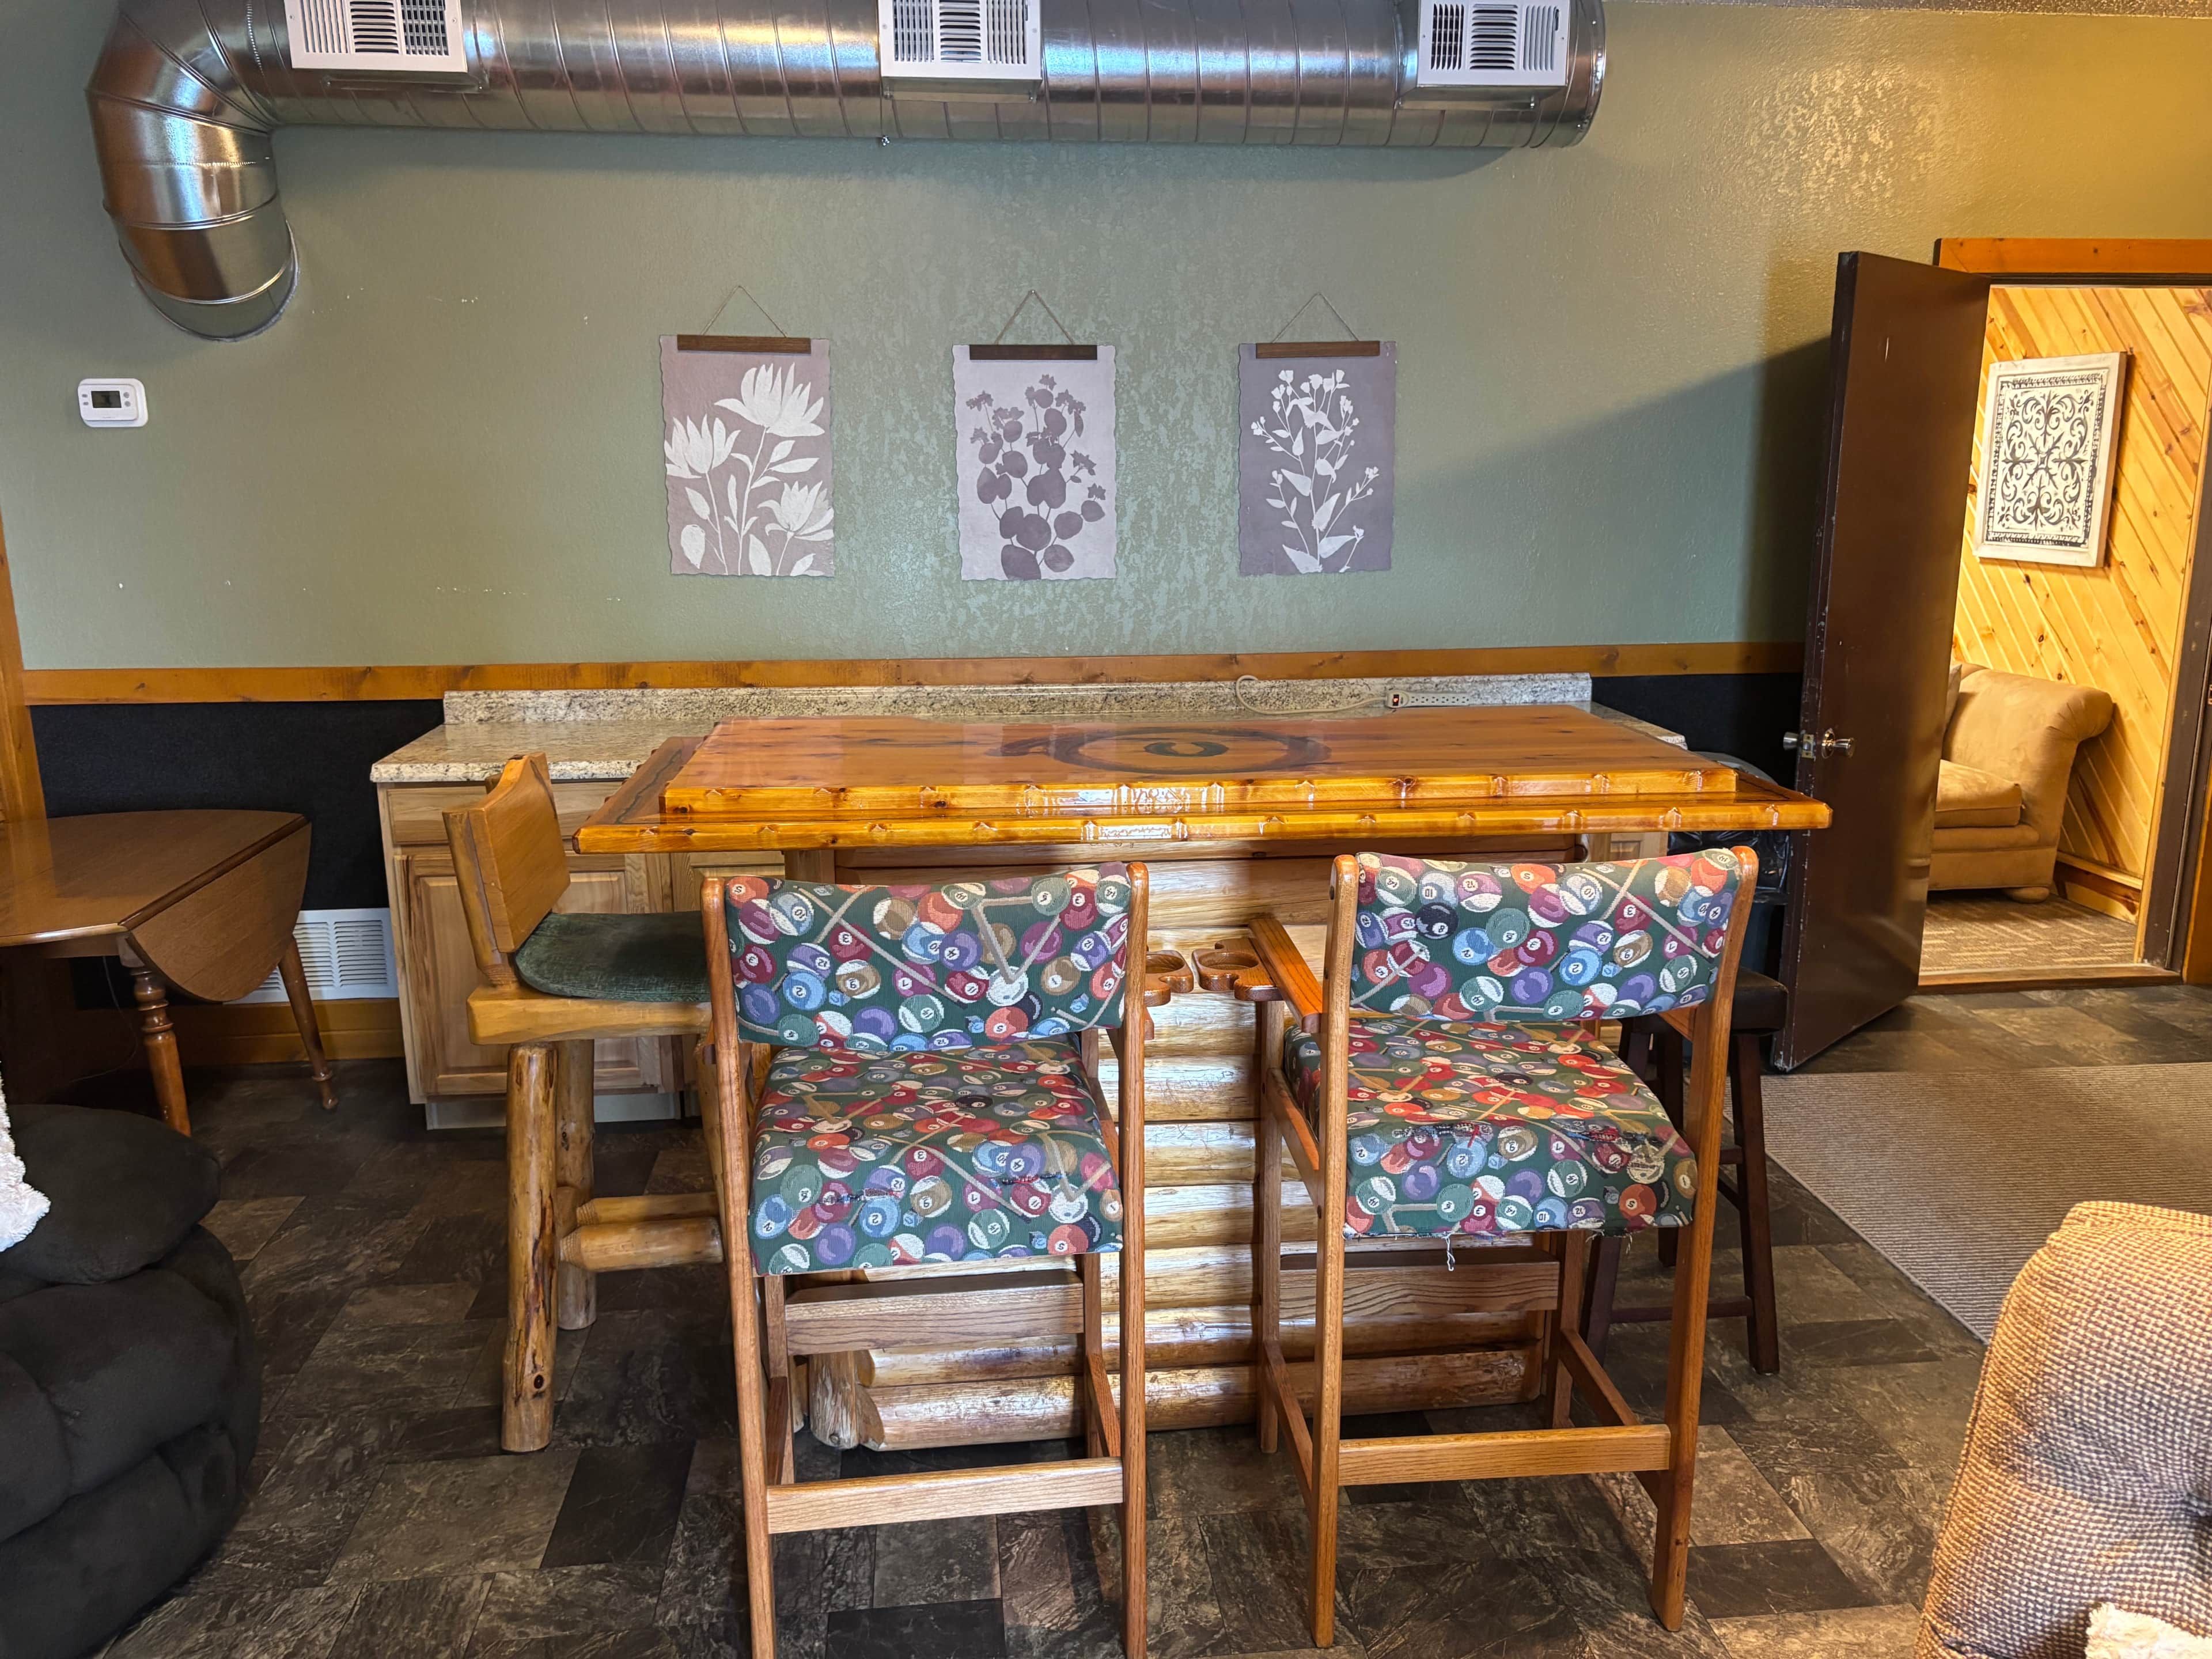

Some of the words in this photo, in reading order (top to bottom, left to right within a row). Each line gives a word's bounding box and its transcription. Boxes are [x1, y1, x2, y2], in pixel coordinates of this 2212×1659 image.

[1465, 880, 1475, 888] 12
[734, 885, 743, 893] 5
[1425, 888, 1433, 897] 10
[1584, 888, 1594, 897] 10
[794, 909, 806, 919] 10
[1627, 907, 1633, 915] 3
[1711, 908, 1719, 918] 4
[842, 934, 850, 944] 3
[1505, 933, 1514, 941] 6
[1624, 950, 1631, 959] 9
[748, 956, 756, 964] 3
[817, 959, 828, 968] 12
[1572, 964, 1580, 973] 2
[796, 987, 803, 997] 2
[1508, 1141, 1516, 1152] 9
[918, 1151, 925, 1159] 3
[1356, 1149, 1365, 1157] 2
[1459, 1156, 1465, 1165] 2
[893, 1180, 903, 1189] 12
[971, 1194, 978, 1202] 7
[1444, 1202, 1452, 1210] 6
[872, 1214, 879, 1224] 2
